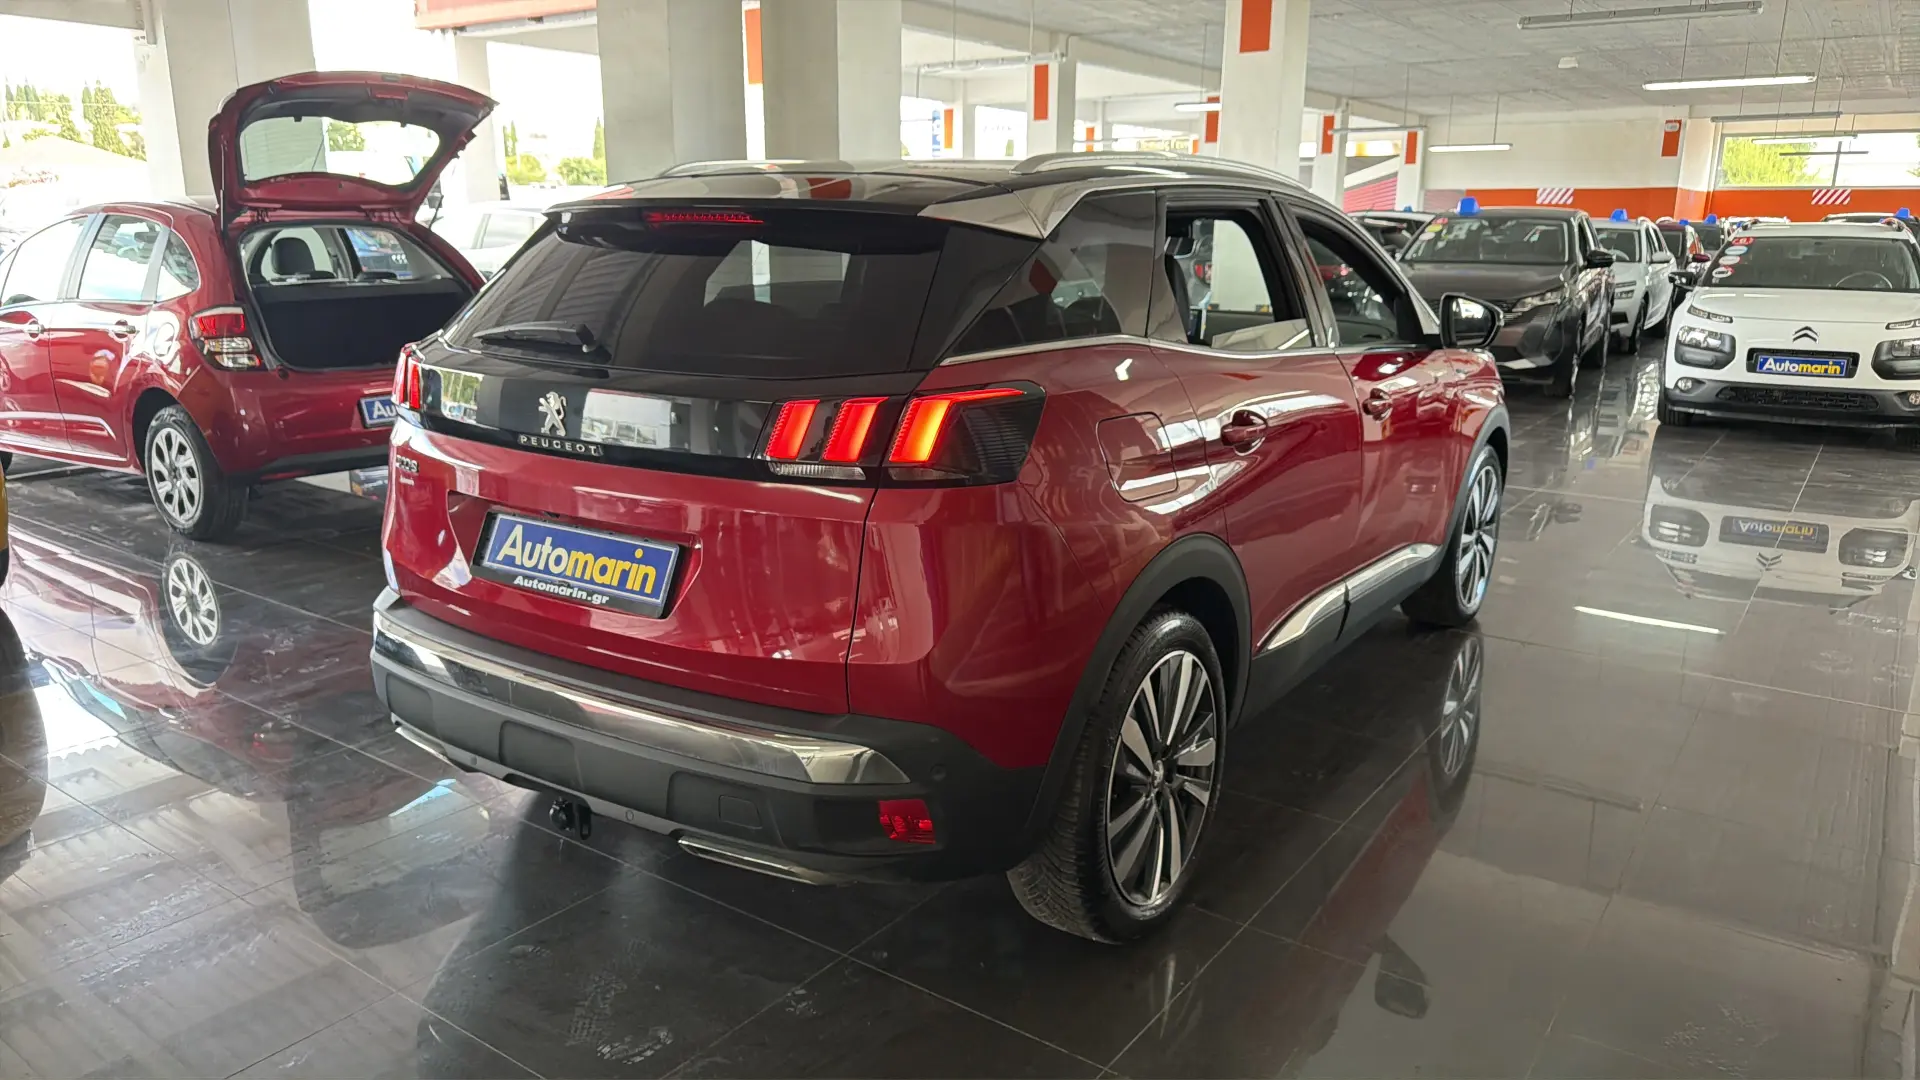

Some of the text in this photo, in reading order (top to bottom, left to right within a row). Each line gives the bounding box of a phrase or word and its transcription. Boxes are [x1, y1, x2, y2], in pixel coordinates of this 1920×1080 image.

[1762, 357, 1841, 375] Automarin
[519, 434, 599, 456] PEUGEOT
[496, 524, 657, 594] Automarin
[513, 575, 610, 605] Automarin.gr
